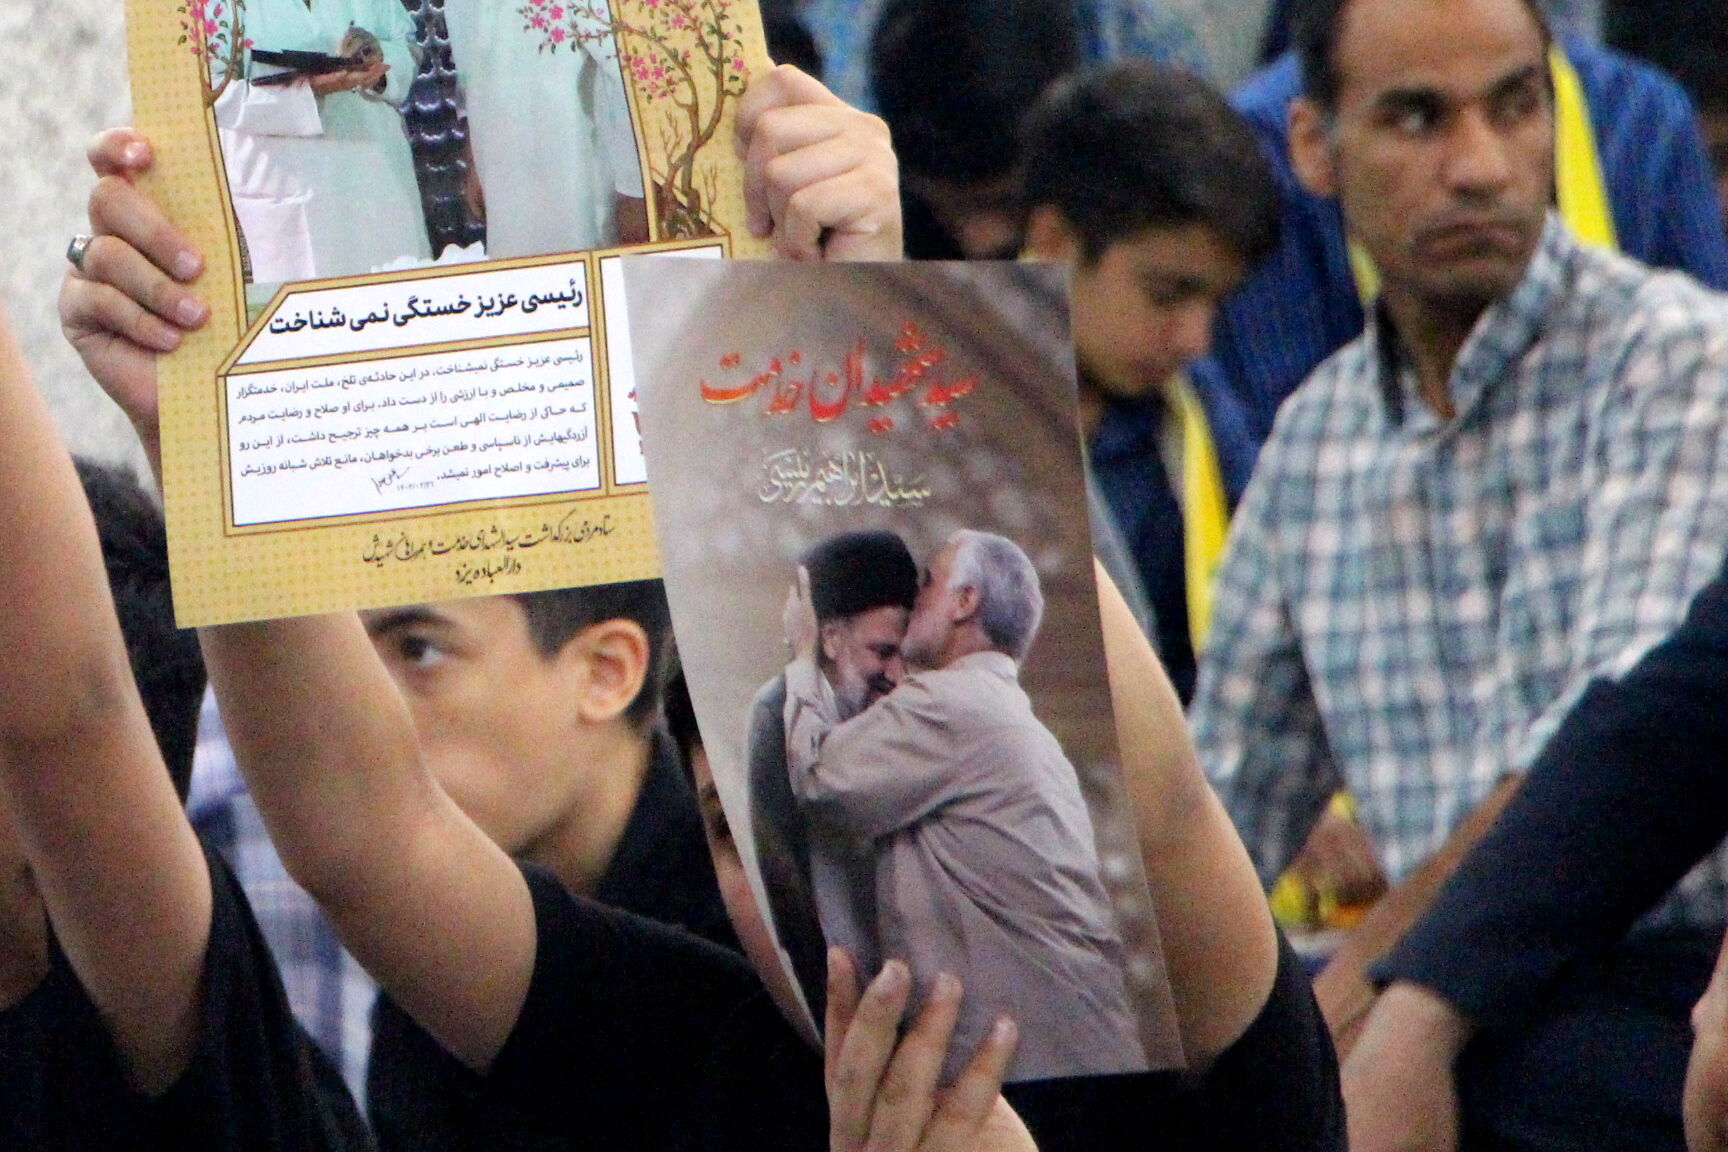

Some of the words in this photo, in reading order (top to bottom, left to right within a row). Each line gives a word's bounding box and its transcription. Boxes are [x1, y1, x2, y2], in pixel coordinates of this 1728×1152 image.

[521, 279, 584, 314] رئیسی
[393, 295, 471, 327] خستگی
[474, 294, 518, 318] عزیز
[269, 309, 346, 334] شناخت
[350, 304, 390, 331] نمی
[528, 355, 550, 368] عزیز
[400, 368, 416, 382] این
[419, 369, 429, 379] در
[808, 321, 944, 433] شهیدان
[311, 377, 334, 389] ملت
[539, 384, 544, 392] و
[547, 378, 584, 392] صمیمی
[699, 349, 804, 414] خدمت
[236, 383, 277, 399] خدمتگزار
[478, 387, 489, 397] با
[491, 389, 497, 397] و
[499, 383, 535, 397] مخلص
[399, 396, 427, 406] دست
[429, 392, 438, 405] از
[439, 392, 447, 403] را
[314, 404, 339, 419] صلاح
[342, 402, 350, 414] او
[353, 400, 375, 412] برای
[569, 402, 587, 413] که
[238, 412, 265, 424] مردم
[267, 408, 303, 421] رضایت
[305, 408, 311, 418] و
[488, 411, 526, 423] رضایت
[529, 407, 538, 420] از
[430, 416, 457, 428] است
[460, 413, 486, 428] الهی
[364, 426, 380, 439] چیز
[384, 422, 409, 433] همه
[412, 423, 427, 433] بر
[276, 434, 284, 447] از
[328, 428, 361, 443] ترجیح
[523, 434, 531, 447] از
[239, 441, 250, 451] رو
[252, 436, 272, 449] این
[442, 441, 468, 455] طعن
[471, 443, 476, 452] و
[415, 447, 440, 460] برخی
[279, 458, 307, 470] شبانه
[309, 454, 332, 470] تلاش
[334, 453, 357, 469] مانع
[534, 458, 569, 471] پیشرفت
[571, 456, 590, 468] برای
[472, 464, 491, 478] امور
[494, 461, 522, 478] اصلاح
[525, 464, 531, 473] و
